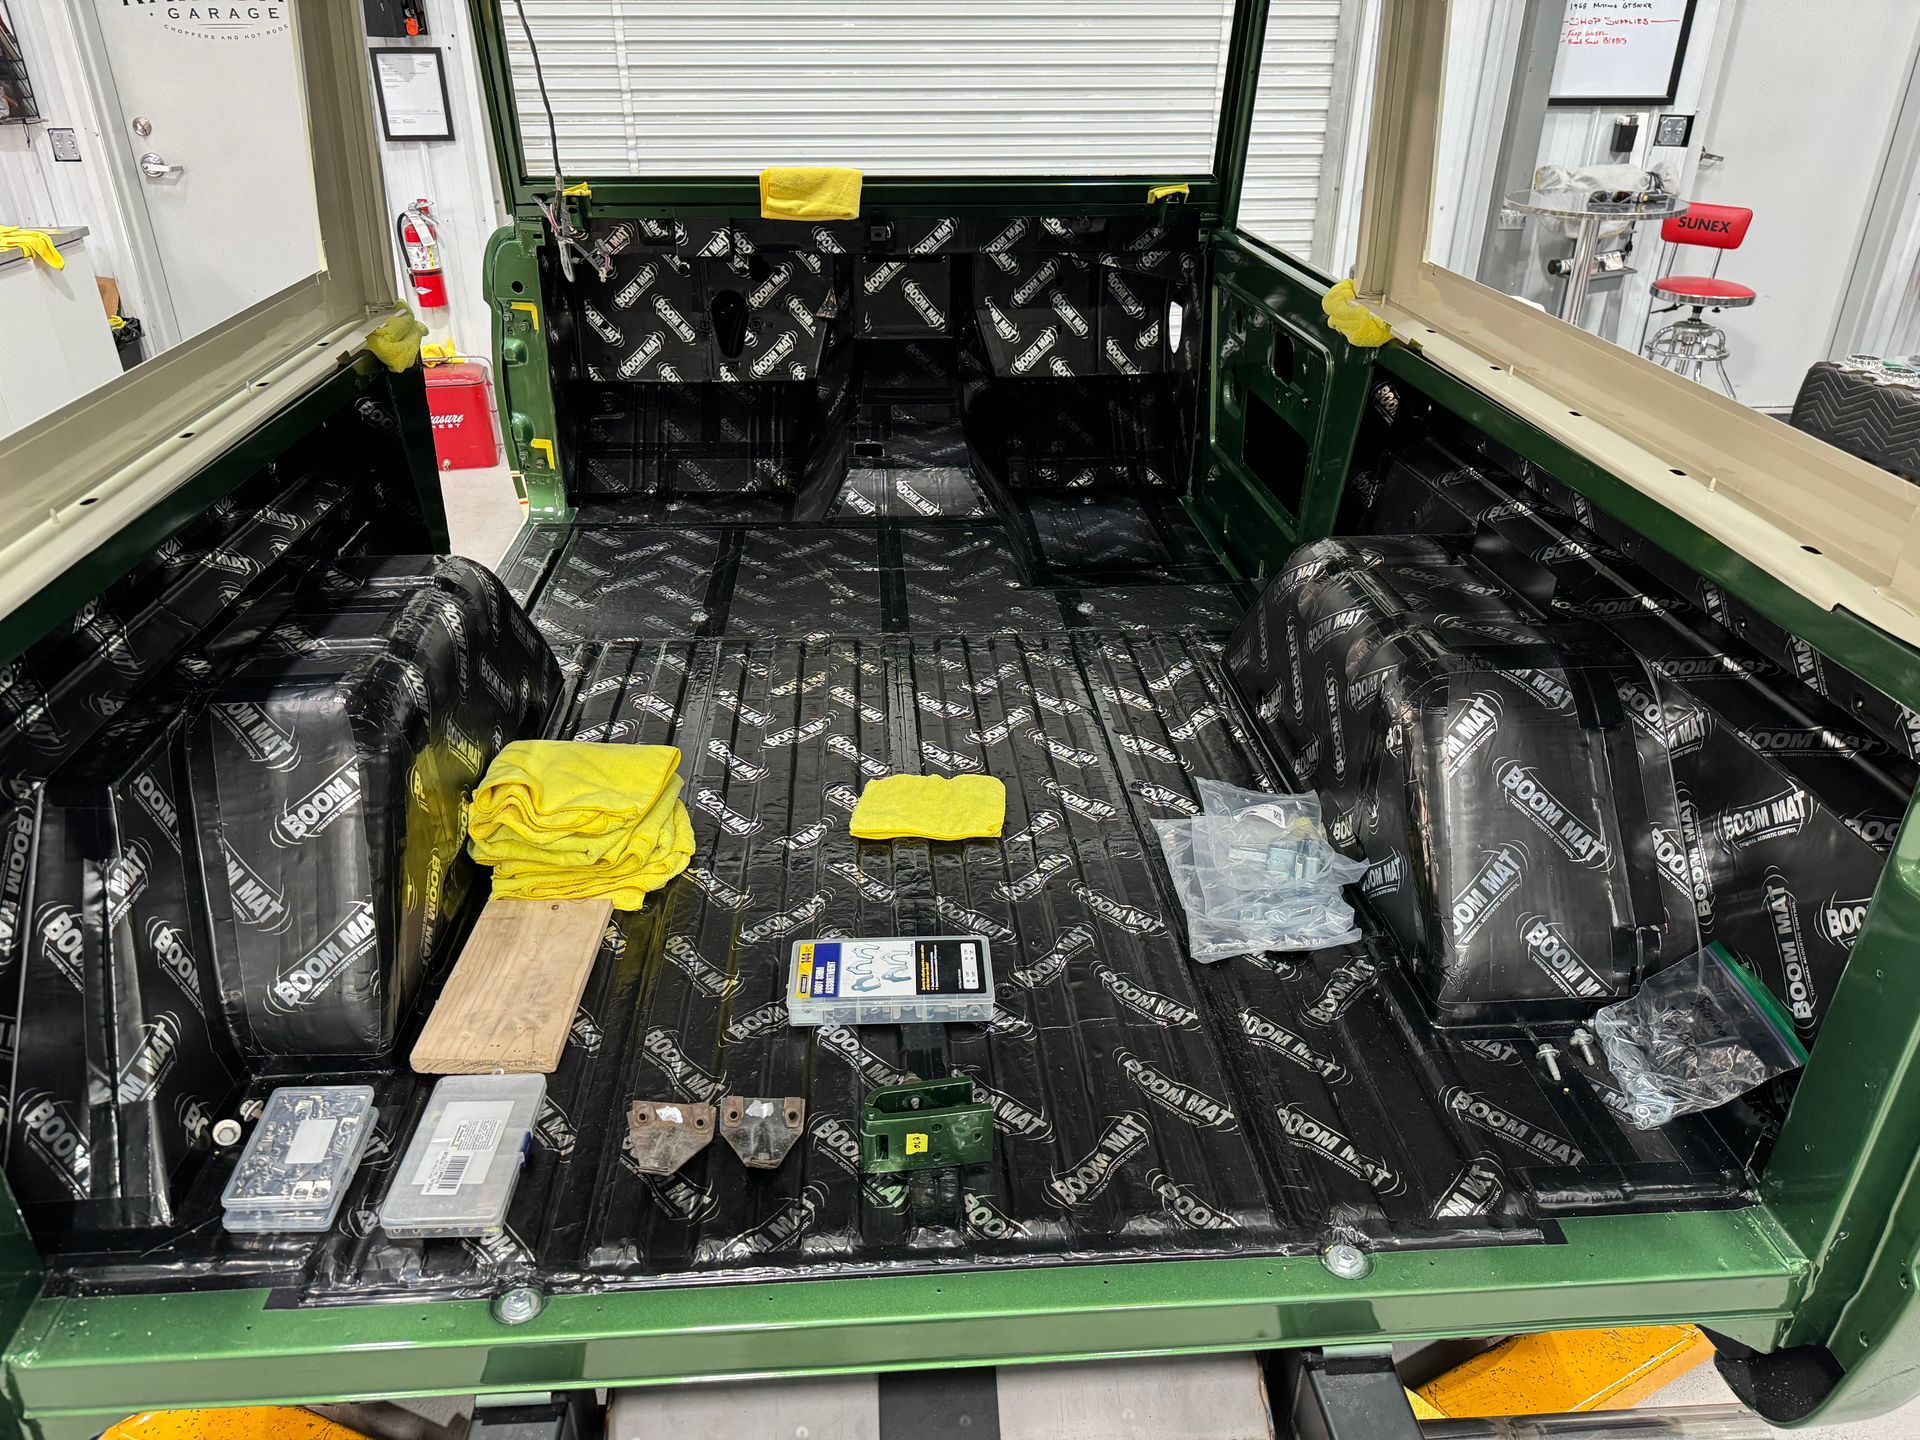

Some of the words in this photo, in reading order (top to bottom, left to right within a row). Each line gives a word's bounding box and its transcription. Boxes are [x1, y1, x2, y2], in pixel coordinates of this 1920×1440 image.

[164, 24, 216, 40] CHOPPERS
[266, 24, 289, 35] RODS
[168, 8, 280, 19] GARAGE
[611, 227, 628, 250] MAT
[709, 231, 729, 255] MAT
[936, 219, 952, 240] MAT
[1007, 219, 1025, 239] MAT
[1677, 215, 1733, 234] SUNEX
[615, 286, 640, 308] BOOM
[639, 266, 654, 286] MAT
[750, 285, 774, 307] BOOM
[864, 267, 891, 292] BOOM
[1014, 279, 1039, 304] BOOM
[1037, 261, 1055, 282] MAT
[656, 298, 679, 324] BOOM
[789, 298, 814, 326] BOOM
[905, 283, 928, 311] BOOM
[926, 307, 944, 327] MAT
[1053, 294, 1077, 318] BOOM
[999, 320, 1016, 337] MAT
[621, 354, 645, 376] BOOM
[644, 334, 660, 355] MAT
[753, 354, 778, 375] BOOM
[777, 334, 793, 354] MAT
[1015, 345, 1039, 371] BOOM
[1037, 330, 1055, 349] MAT
[917, 498, 942, 517] MAT
[1296, 563, 1322, 583] MAT
[444, 603, 468, 649] BOOM
[1308, 622, 1333, 650] BOOM
[1334, 610, 1364, 630] MAT
[481, 660, 500, 692] BOOM
[1326, 676, 1338, 715] MAT
[1501, 672, 1527, 690] ACOUSTIC
[1525, 688, 1548, 707] CONTROL
[1531, 675, 1573, 708] MAT
[1456, 697, 1496, 740] MAT
[1477, 728, 1496, 749] CONTROL
[1680, 712, 1707, 741] MAT
[249, 721, 293, 761] MAT
[466, 739, 482, 773] MAT
[1331, 718, 1345, 774] BOOM
[281, 776, 352, 839] BOOM
[316, 812, 339, 833] THERMAL
[1502, 765, 1564, 827] BOOM
[1560, 821, 1607, 862] MAT
[1722, 806, 1769, 840] BOOM
[1772, 790, 1806, 822] MAT
[1509, 798, 1532, 818] THERMAL
[1531, 817, 1553, 840] ACOUSTIC
[1553, 837, 1574, 859] CONTROL
[1758, 832, 1778, 844] ACOUSTIC
[1778, 828, 1798, 838] CONTROL
[5, 813, 32, 895] BOOM
[1384, 857, 1400, 883] MAT
[1480, 848, 1520, 894] MAT
[236, 879, 284, 923] MAT
[1687, 849, 1712, 916] BOOM
[739, 916, 795, 943] BOOM
[791, 894, 826, 926] MAT
[937, 894, 980, 924] BOOM
[974, 918, 1011, 939] MAT
[1126, 910, 1164, 932] MAT
[1481, 901, 1501, 925] ACOUSTIC
[1500, 883, 1519, 903] CONTROL
[1767, 885, 1791, 933] MAT
[332, 953, 358, 979] ACOUSTIC
[666, 936, 702, 975] BOOM
[699, 971, 738, 999] MAT
[1013, 952, 1063, 986] BOOM
[1057, 926, 1092, 957] MAT
[1525, 921, 1584, 983] BOOM
[273, 941, 344, 1007] BOOM
[1532, 956, 1551, 976] THERMAL
[1550, 975, 1569, 996] ACOUSTIC
[1781, 940, 1812, 1018] BOOM
[1101, 970, 1157, 1009] BOOM
[1154, 999, 1197, 1025] MAT
[137, 1020, 175, 1075] MAT
[819, 1022, 872, 1066] BOOM
[1238, 1012, 1294, 1046] BOOM
[1292, 1043, 1339, 1076] MAT
[645, 1030, 693, 1081] BOOM
[688, 1076, 725, 1101] MAT
[1124, 1060, 1184, 1105] BOOM
[1185, 1093, 1235, 1126] MAT
[997, 1102, 1047, 1134] MAT
[1451, 1091, 1526, 1141] BOOM
[1531, 1127, 1586, 1166] MAT
[1052, 1152, 1112, 1205] BOOM
[1102, 1114, 1146, 1154] MAT
[1125, 1142, 1147, 1162] CONTROL
[1277, 1107, 1342, 1150] BOOM
[1340, 1147, 1392, 1186] MAT
[1464, 1116, 1493, 1135] THERMAL
[1493, 1131, 1526, 1152] ACOUSTIC
[1526, 1148, 1557, 1166] CONTROL
[1334, 1159, 1361, 1178] CONTROL
[768, 1193, 815, 1240] MAT
